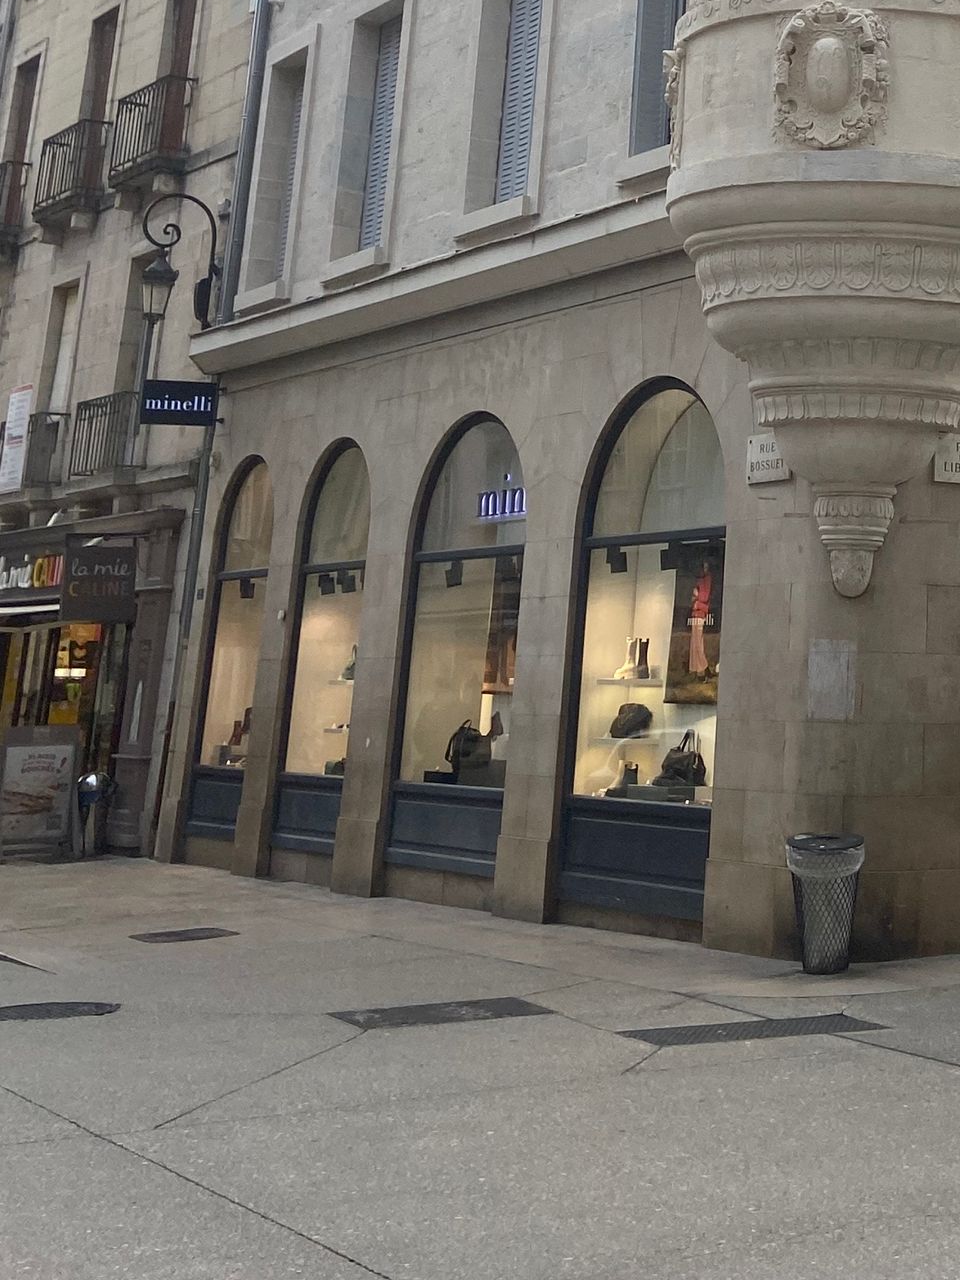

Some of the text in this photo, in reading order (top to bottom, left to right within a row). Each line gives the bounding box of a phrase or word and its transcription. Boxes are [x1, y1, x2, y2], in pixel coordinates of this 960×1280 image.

[145, 394, 212, 411] minelli
[759, 441, 776, 453] RUE
[750, 458, 784, 473] BOSSUET
[71, 558, 131, 576] la mie
[69, 581, 133, 597] CLINE
